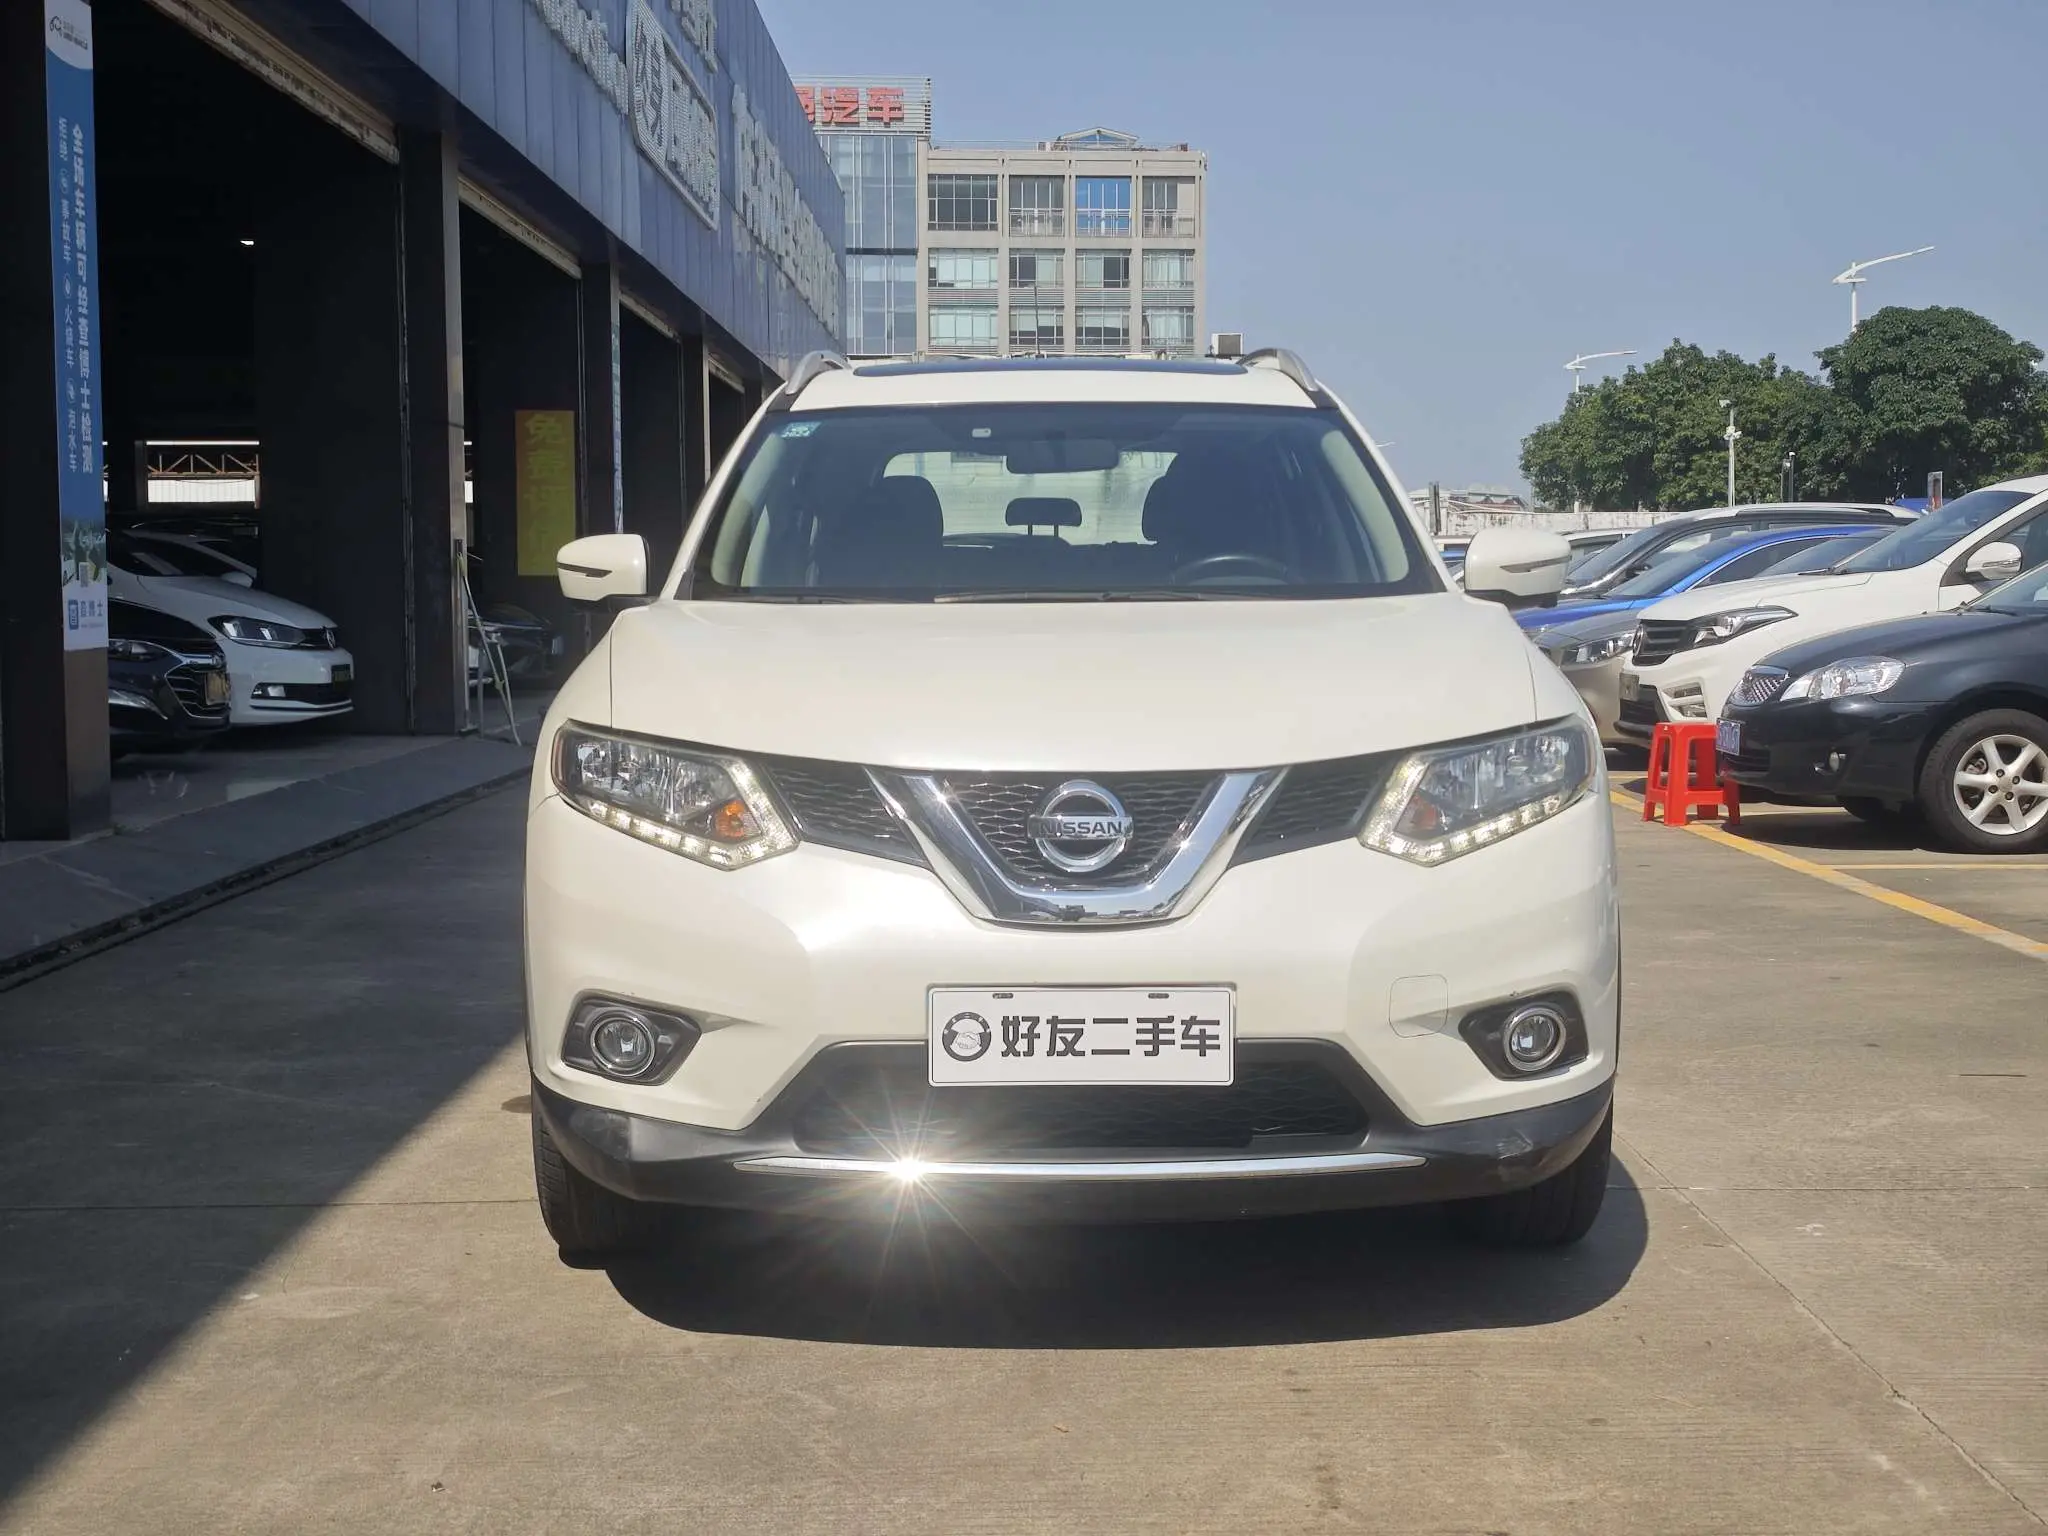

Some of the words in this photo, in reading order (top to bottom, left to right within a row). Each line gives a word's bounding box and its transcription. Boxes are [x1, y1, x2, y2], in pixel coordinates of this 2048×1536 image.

[1039, 820, 1122, 835] NISSAN
[1001, 1015, 1221, 1057] 好友二手车
